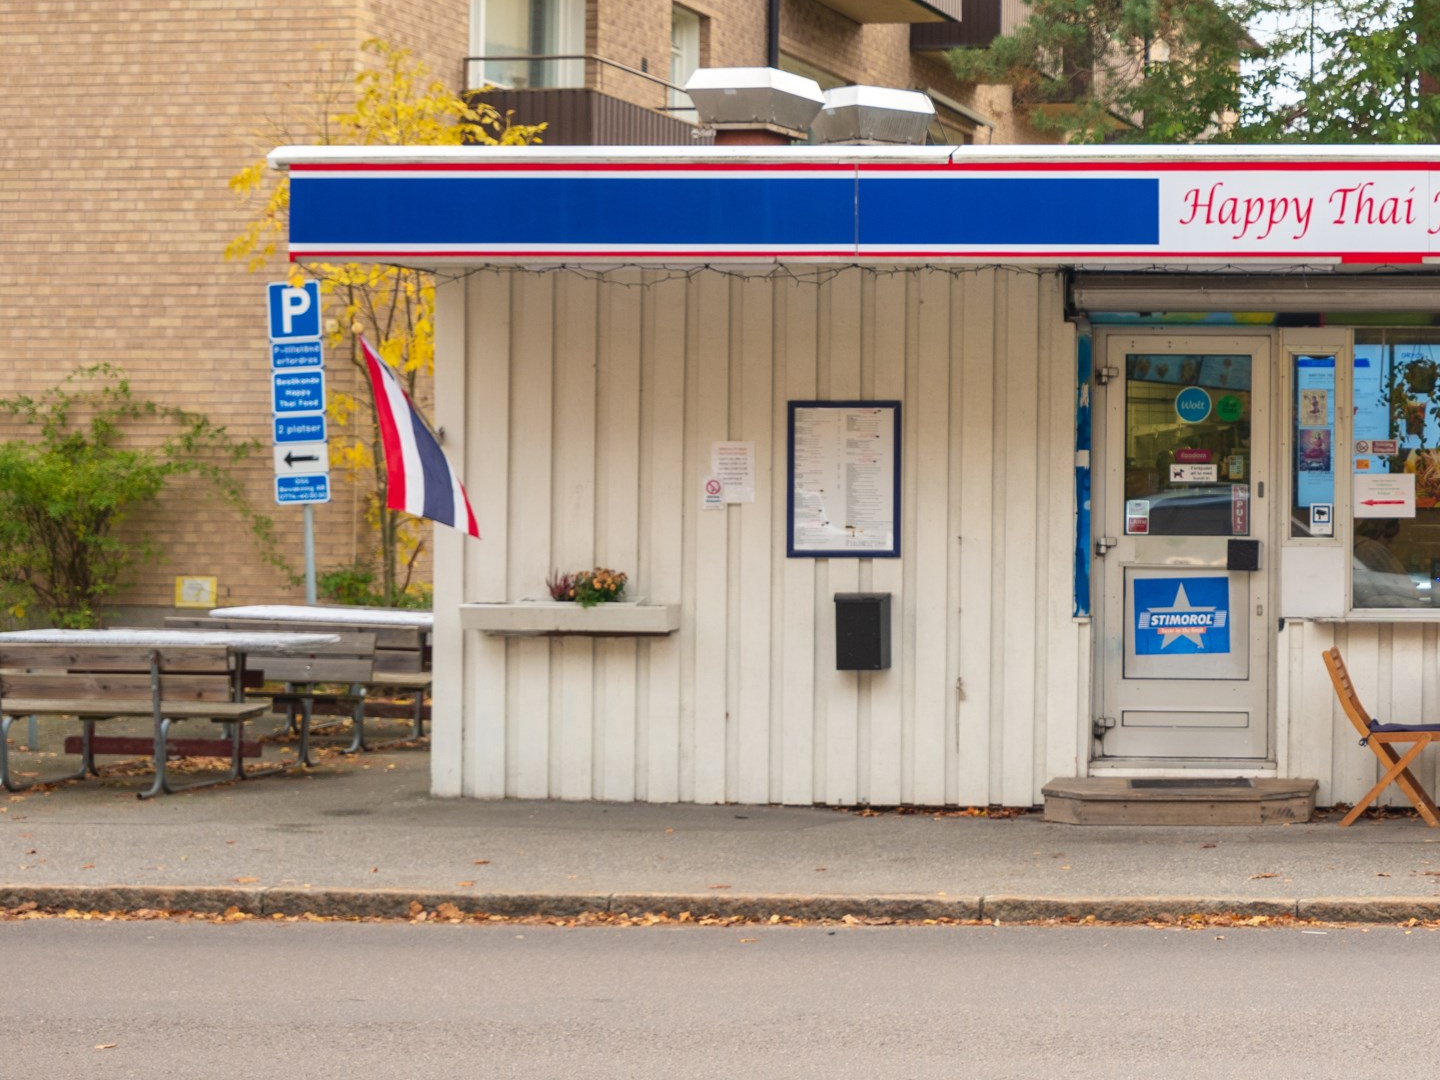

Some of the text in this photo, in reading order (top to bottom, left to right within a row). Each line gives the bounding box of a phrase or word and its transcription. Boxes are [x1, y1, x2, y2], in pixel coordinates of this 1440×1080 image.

[1179, 181, 1315, 240] Happy
[1328, 182, 1417, 226] Thai
[281, 287, 312, 334] P
[1181, 400, 1205, 410] Wolt
[1151, 614, 1213, 626] STIMOROL
